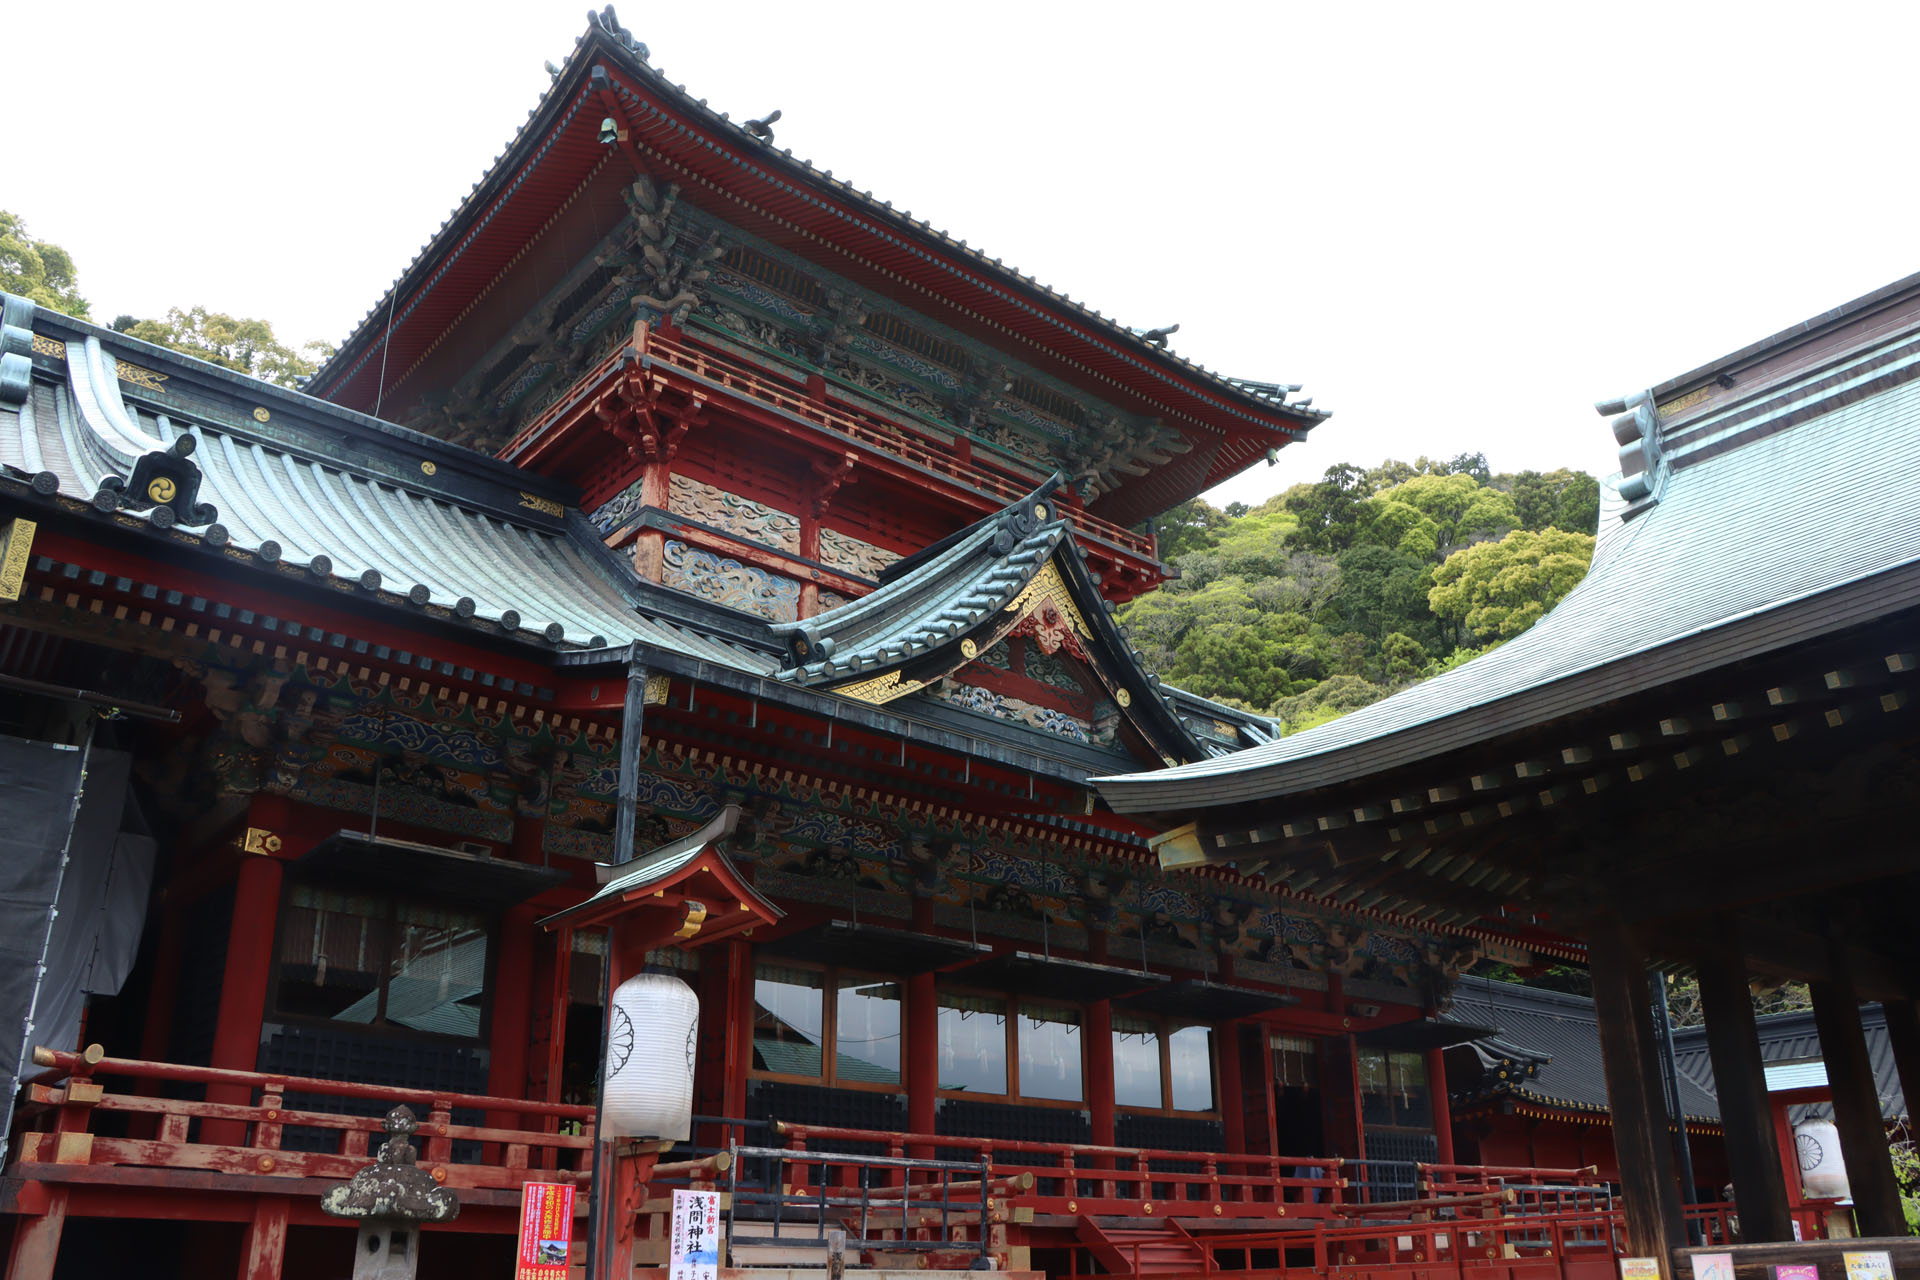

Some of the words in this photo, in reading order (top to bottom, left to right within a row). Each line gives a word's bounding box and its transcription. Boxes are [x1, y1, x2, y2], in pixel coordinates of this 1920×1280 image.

[687, 1196, 704, 1254] 浅間神社
[707, 1195, 717, 1234] 富士新宮
